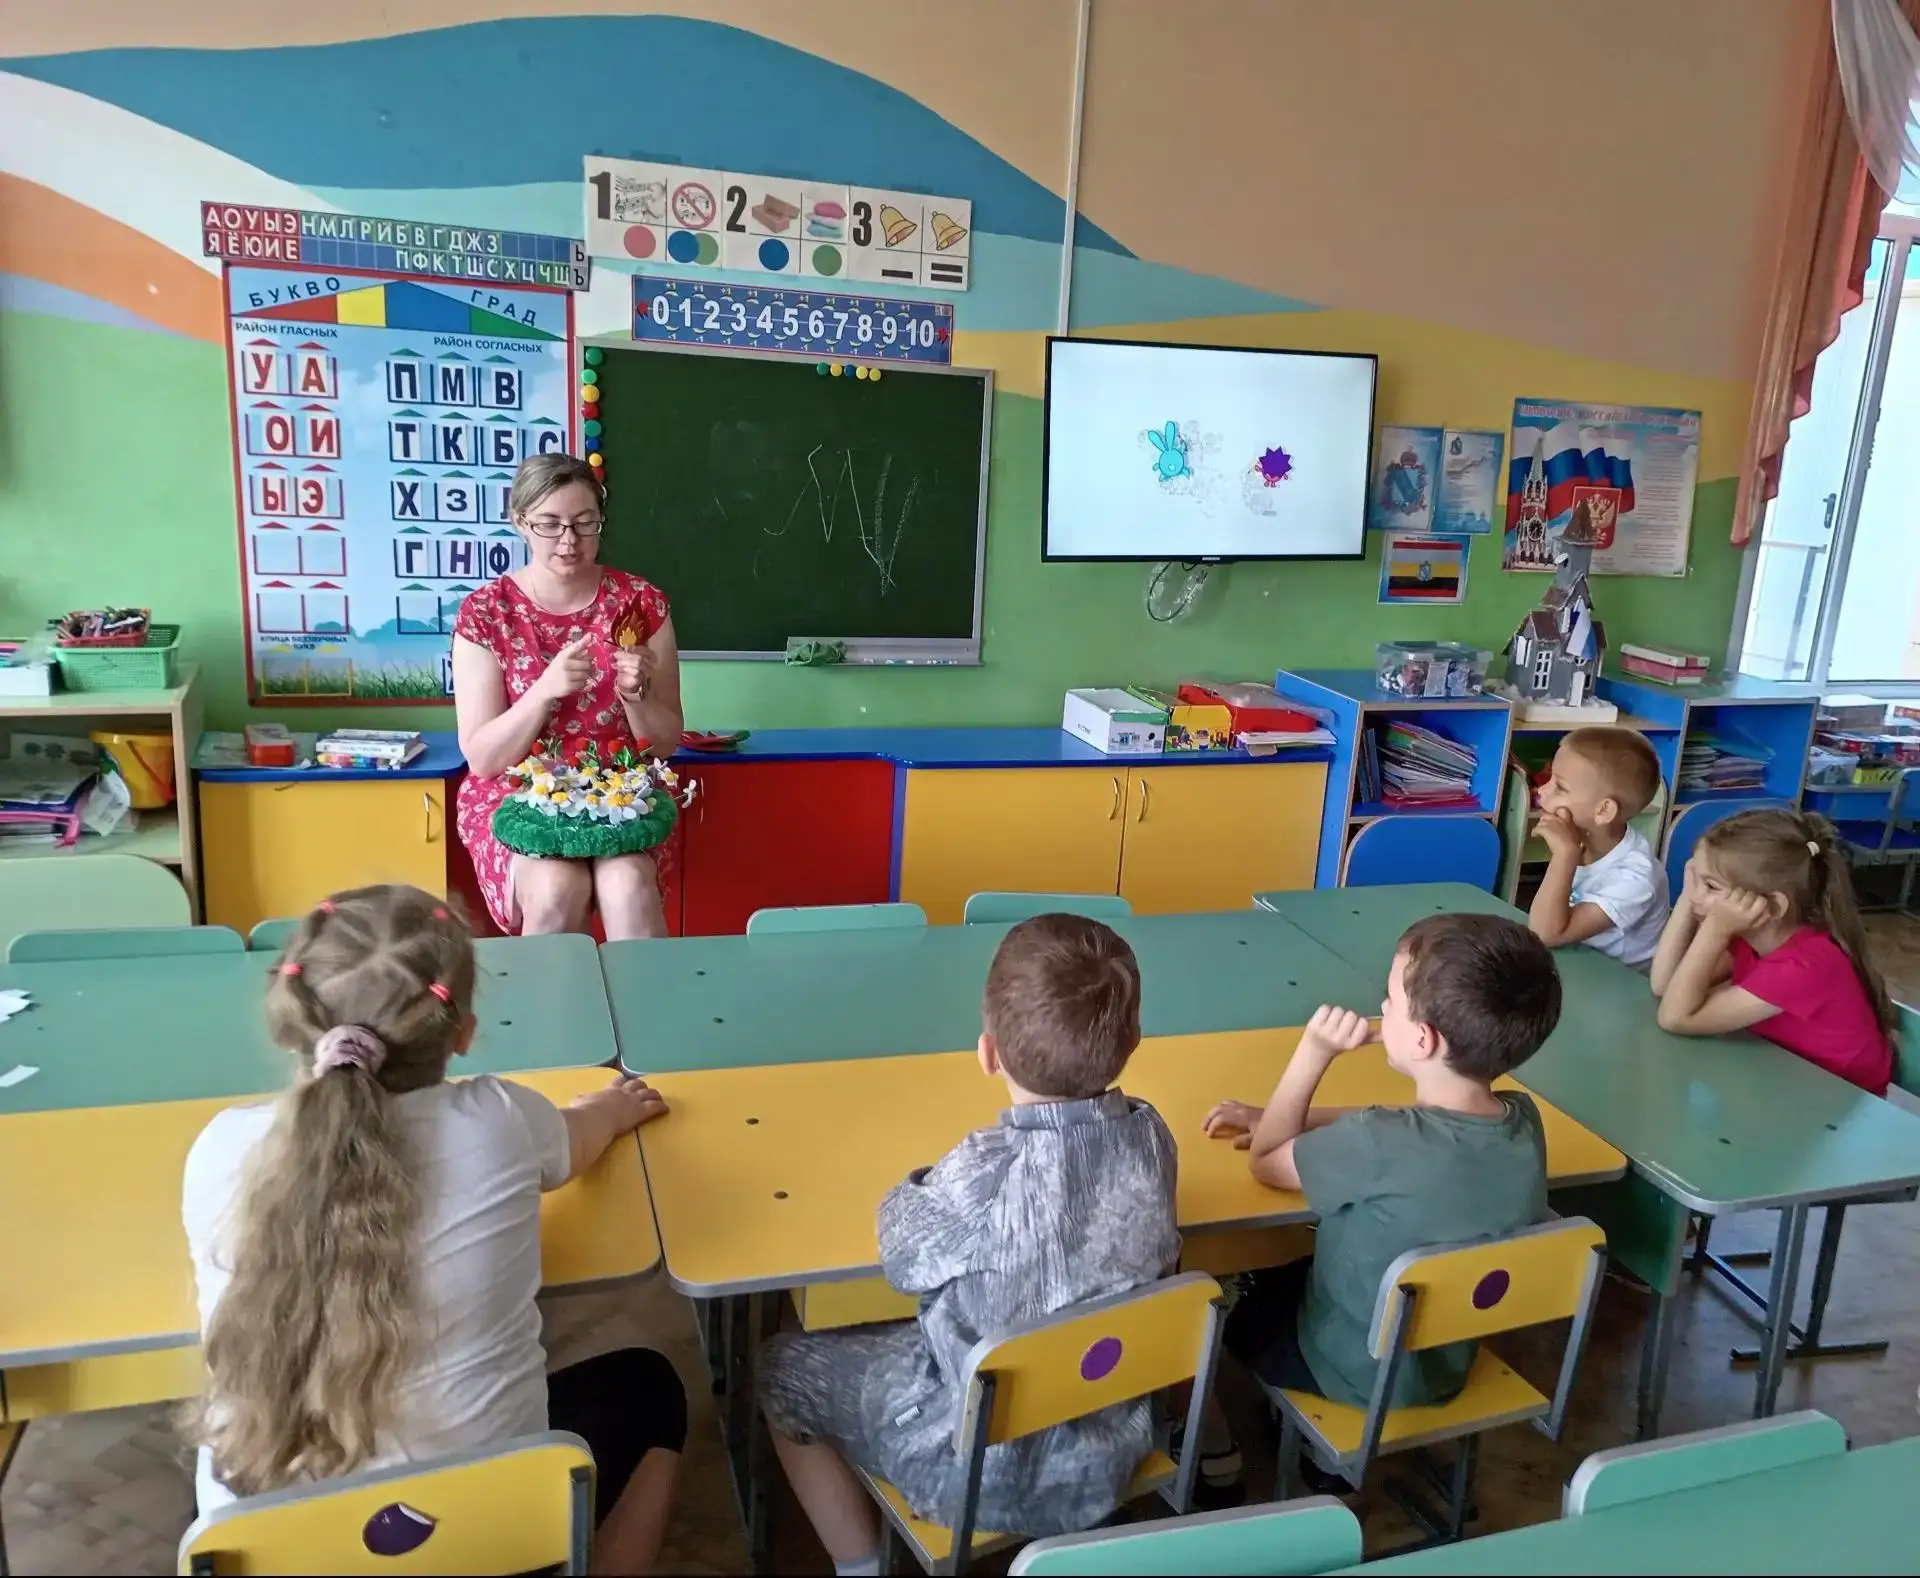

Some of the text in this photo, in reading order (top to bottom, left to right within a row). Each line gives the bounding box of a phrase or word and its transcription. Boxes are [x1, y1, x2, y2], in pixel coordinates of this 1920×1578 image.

[589, 171, 872, 247] 1 2 3
[248, 277, 537, 327] БУКВО ГРАД
[653, 295, 935, 348] 0 1 2 3 4 5 6 7 8 9 10
[235, 321, 338, 338] РАЙОН ГЛАСНЫХ
[433, 336, 543, 353] РАЙОН СОГЛАСНЫХ
